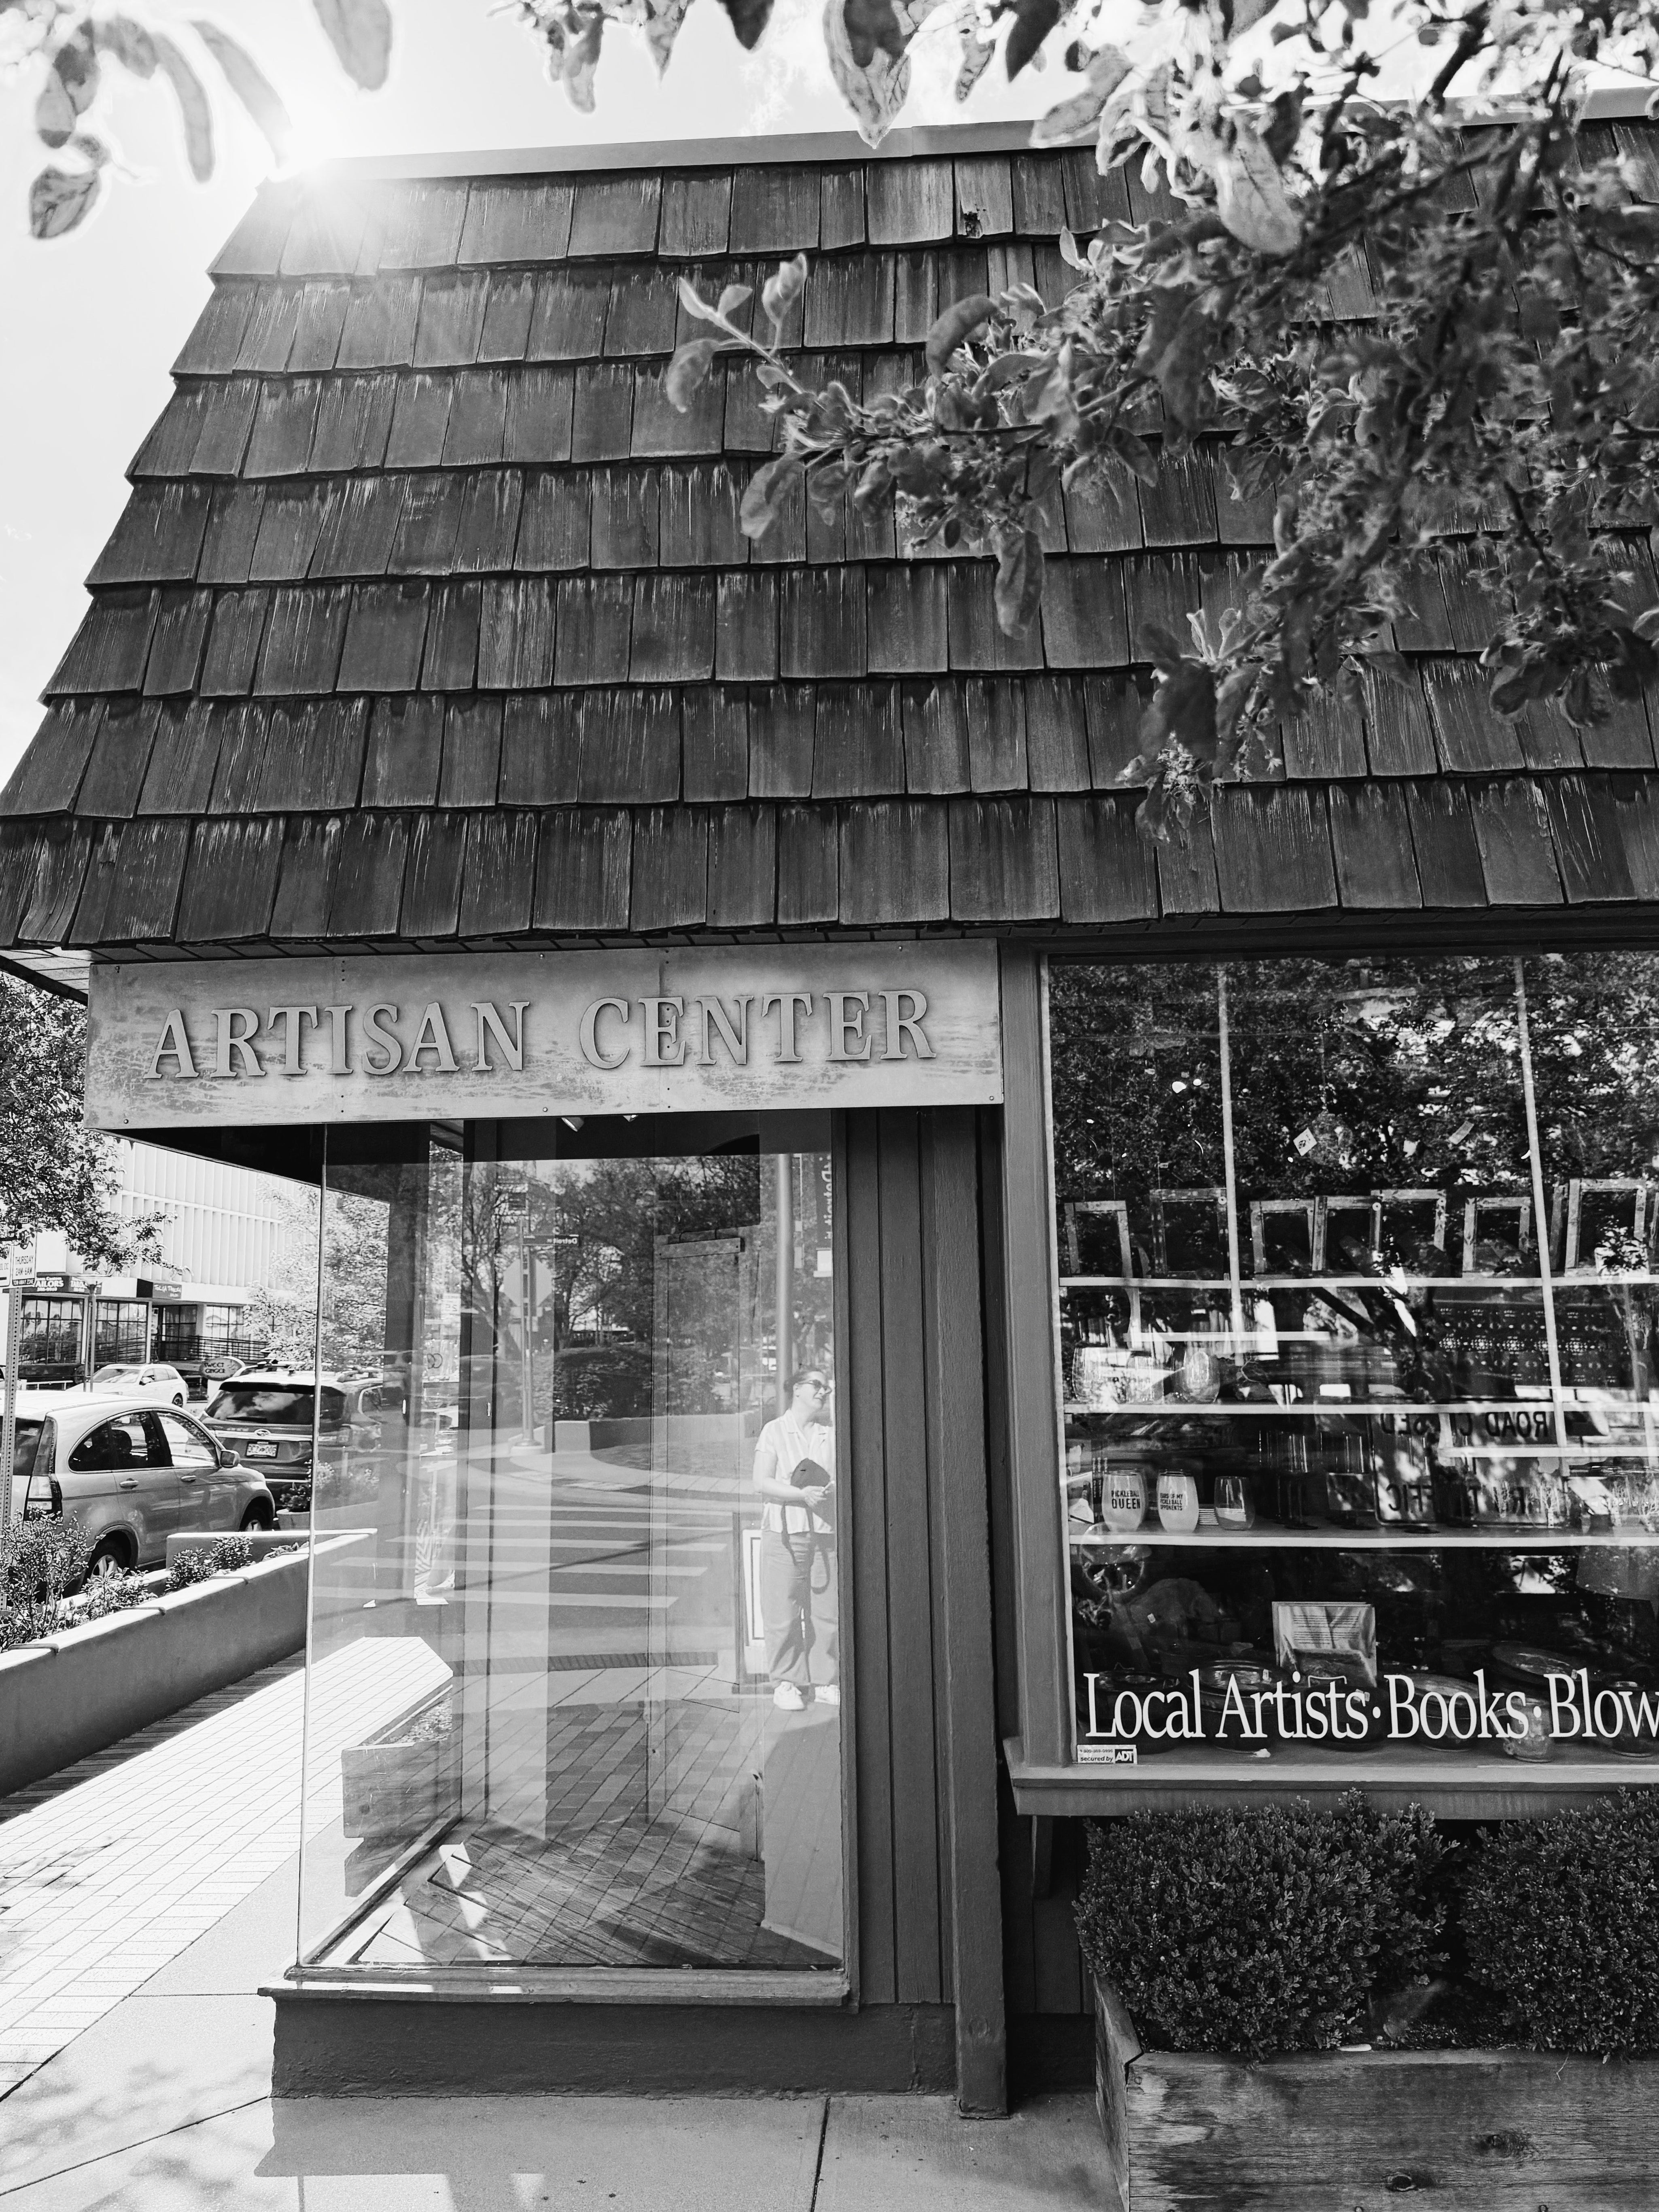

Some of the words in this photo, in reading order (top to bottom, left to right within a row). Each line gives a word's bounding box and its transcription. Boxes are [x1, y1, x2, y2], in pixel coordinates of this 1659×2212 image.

[143, 1001, 530, 1079] ARTISAN
[579, 990, 937, 1069] CENTER
[15, 1255, 33, 1264] THURSDAY
[1112, 1498, 1140, 1509] QUEEN
[1083, 1669, 1206, 1739] Local
[1215, 1671, 1368, 1739] Artists
[1383, 1669, 1529, 1739] Books
[1544, 1668, 1659, 1738] Blow
[1116, 1751, 1133, 1761] ADT
